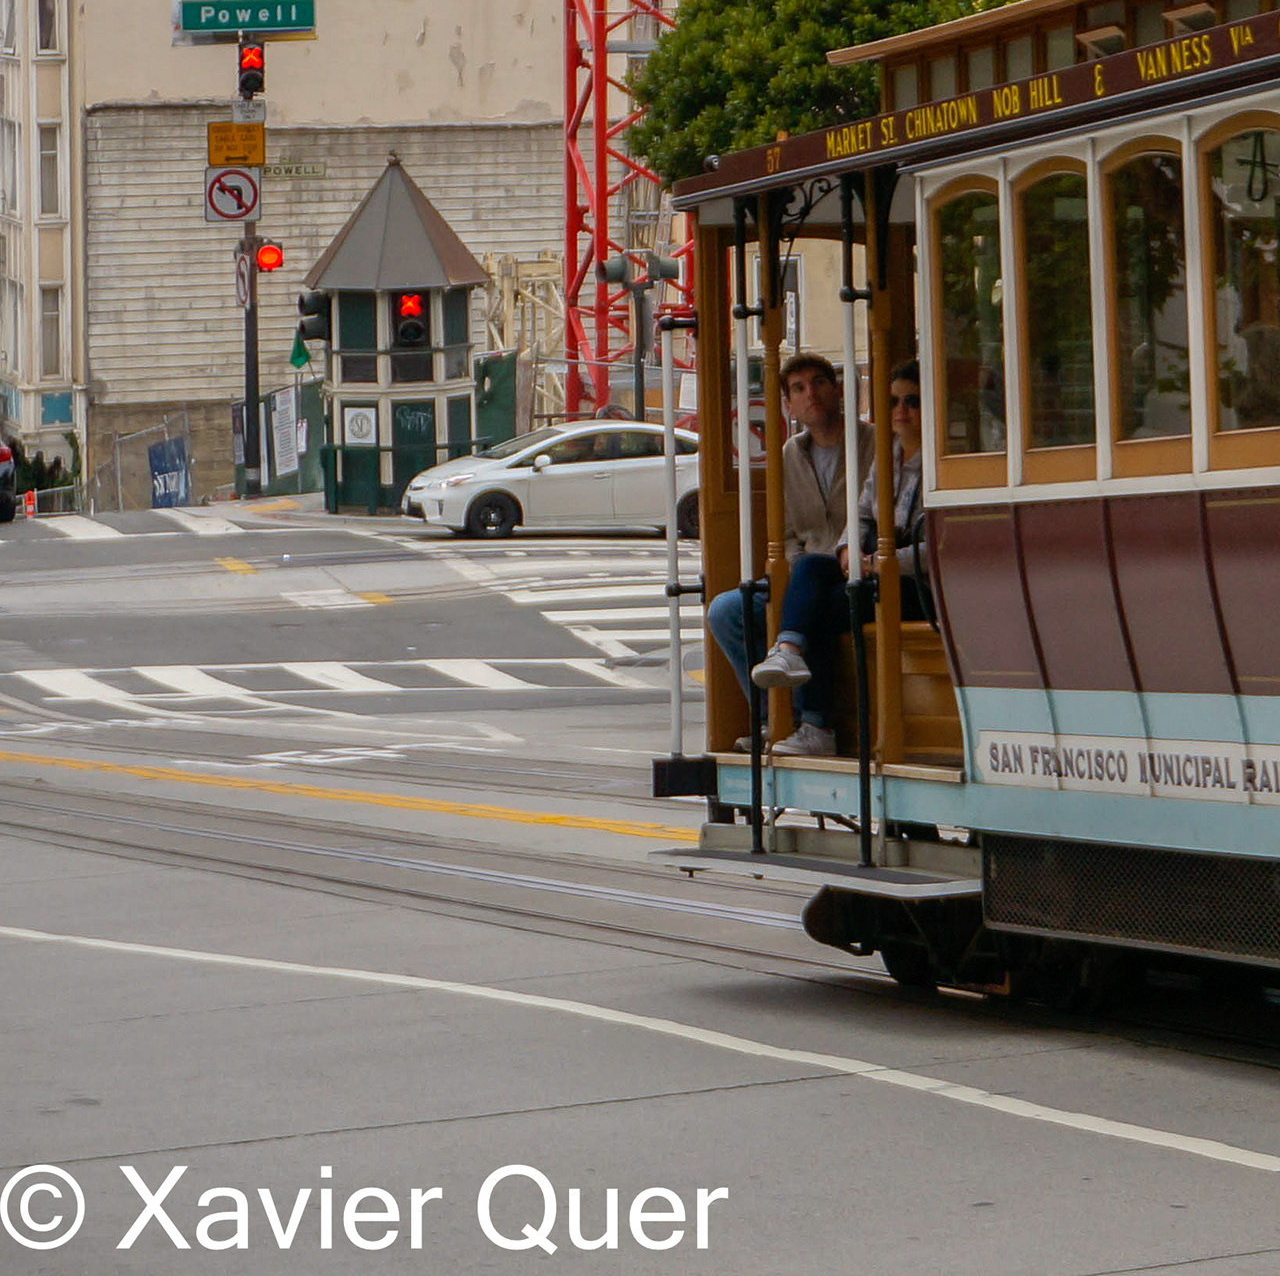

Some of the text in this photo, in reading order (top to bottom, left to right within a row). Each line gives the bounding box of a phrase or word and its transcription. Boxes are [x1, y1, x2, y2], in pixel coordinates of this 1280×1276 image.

[201, 5, 297, 24] Powell
[766, 146, 782, 173] 57
[826, 122, 873, 159] MARKET
[905, 94, 978, 140] CHINATOWN
[993, 85, 1020, 118] NOB
[1029, 74, 1063, 110] HILL
[1094, 64, 1105, 97] &
[1137, 46, 1168, 82] VAN
[1170, 35, 1211, 72] NESS
[263, 165, 320, 176] POWELL
[989, 741, 1024, 775] SAN
[1028, 744, 1130, 785] FRANCISCO
